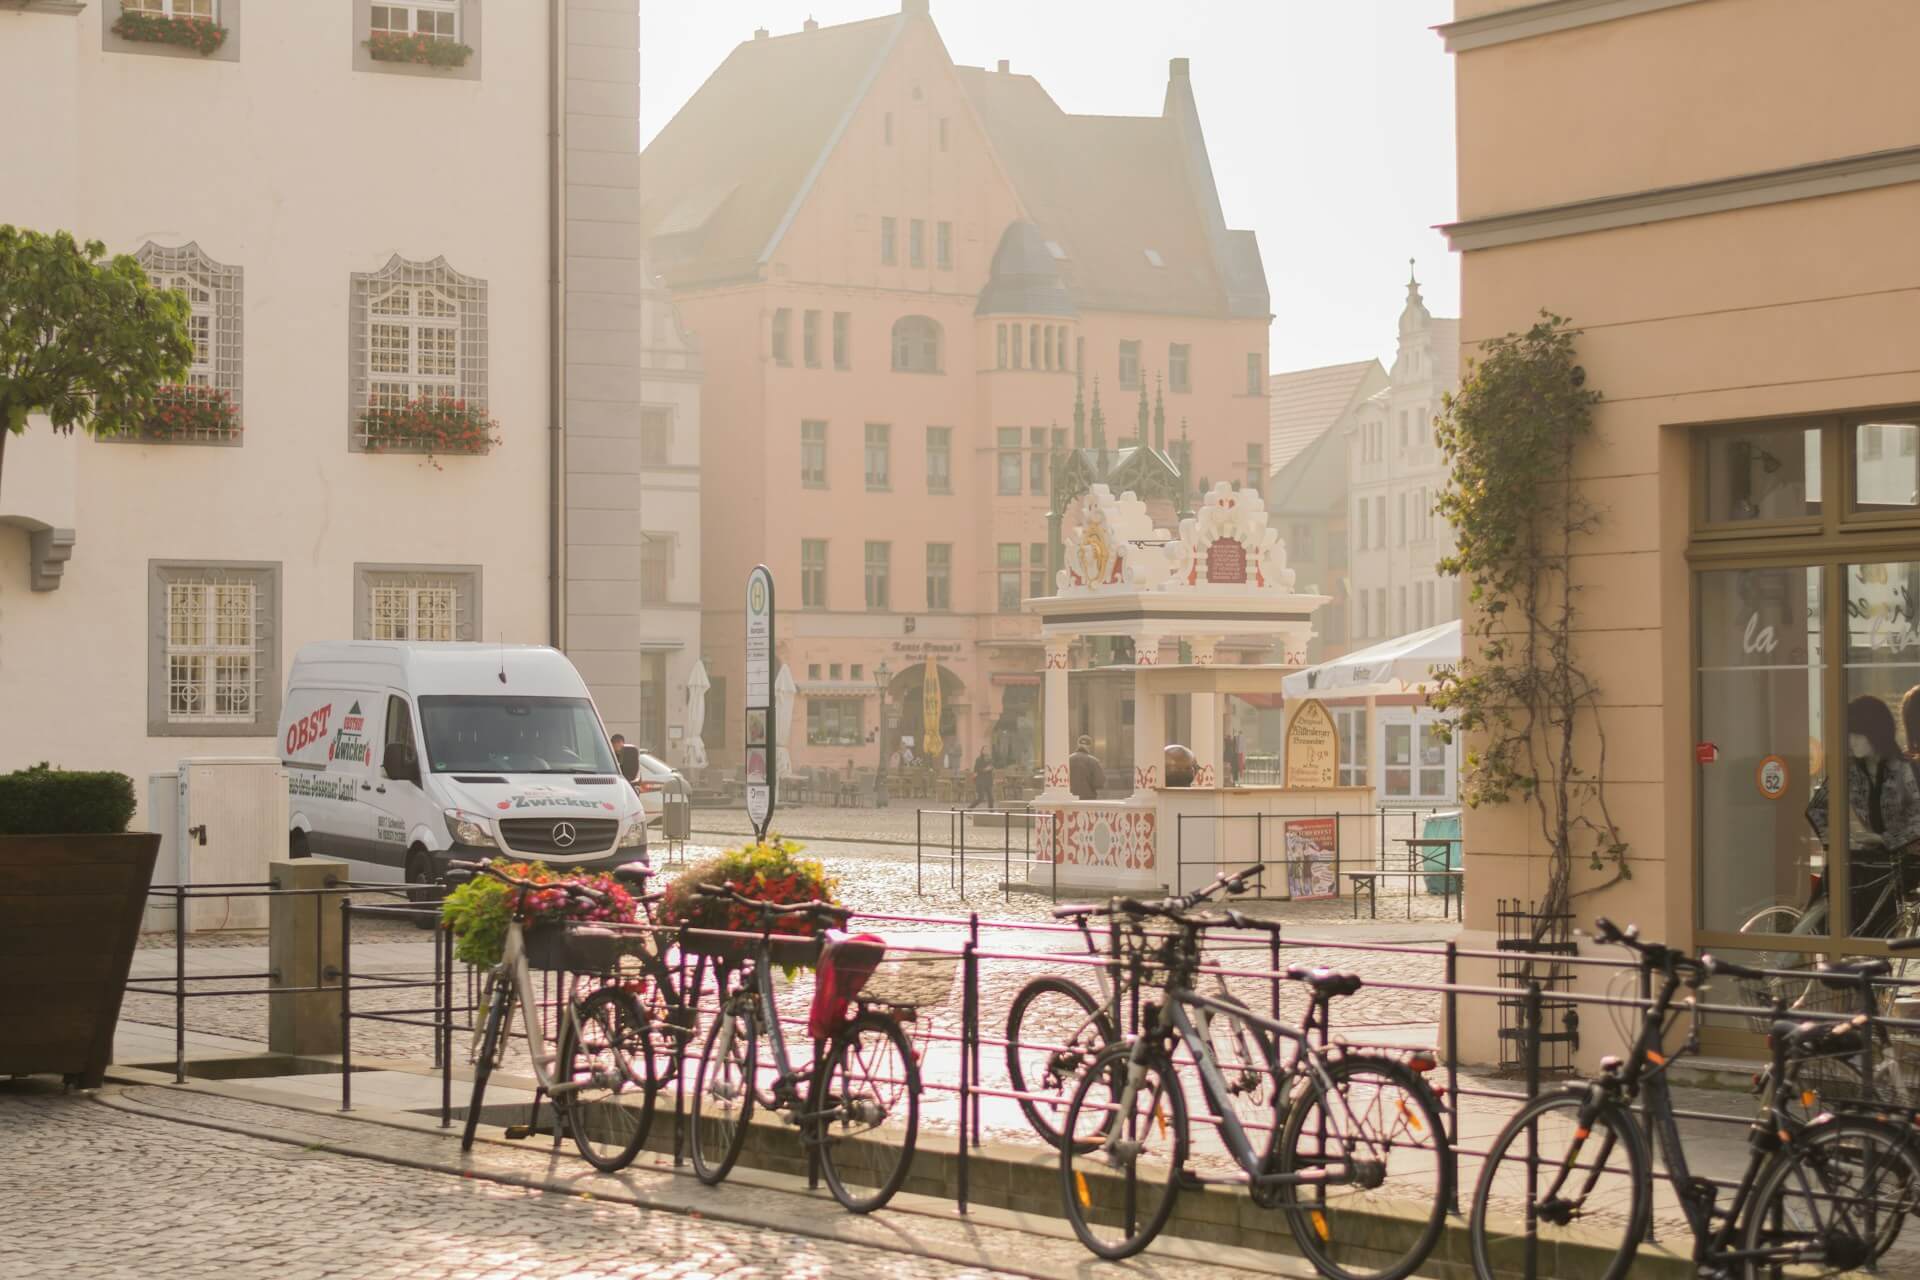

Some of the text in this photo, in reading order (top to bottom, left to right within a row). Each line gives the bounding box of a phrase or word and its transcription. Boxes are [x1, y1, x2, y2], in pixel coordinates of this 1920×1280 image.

[1744, 611, 1778, 654] la
[286, 703, 332, 755] OBST
[334, 728, 366, 762] Zwicker
[1766, 775, 1780, 790] 52
[511, 795, 604, 809] Zwicker
